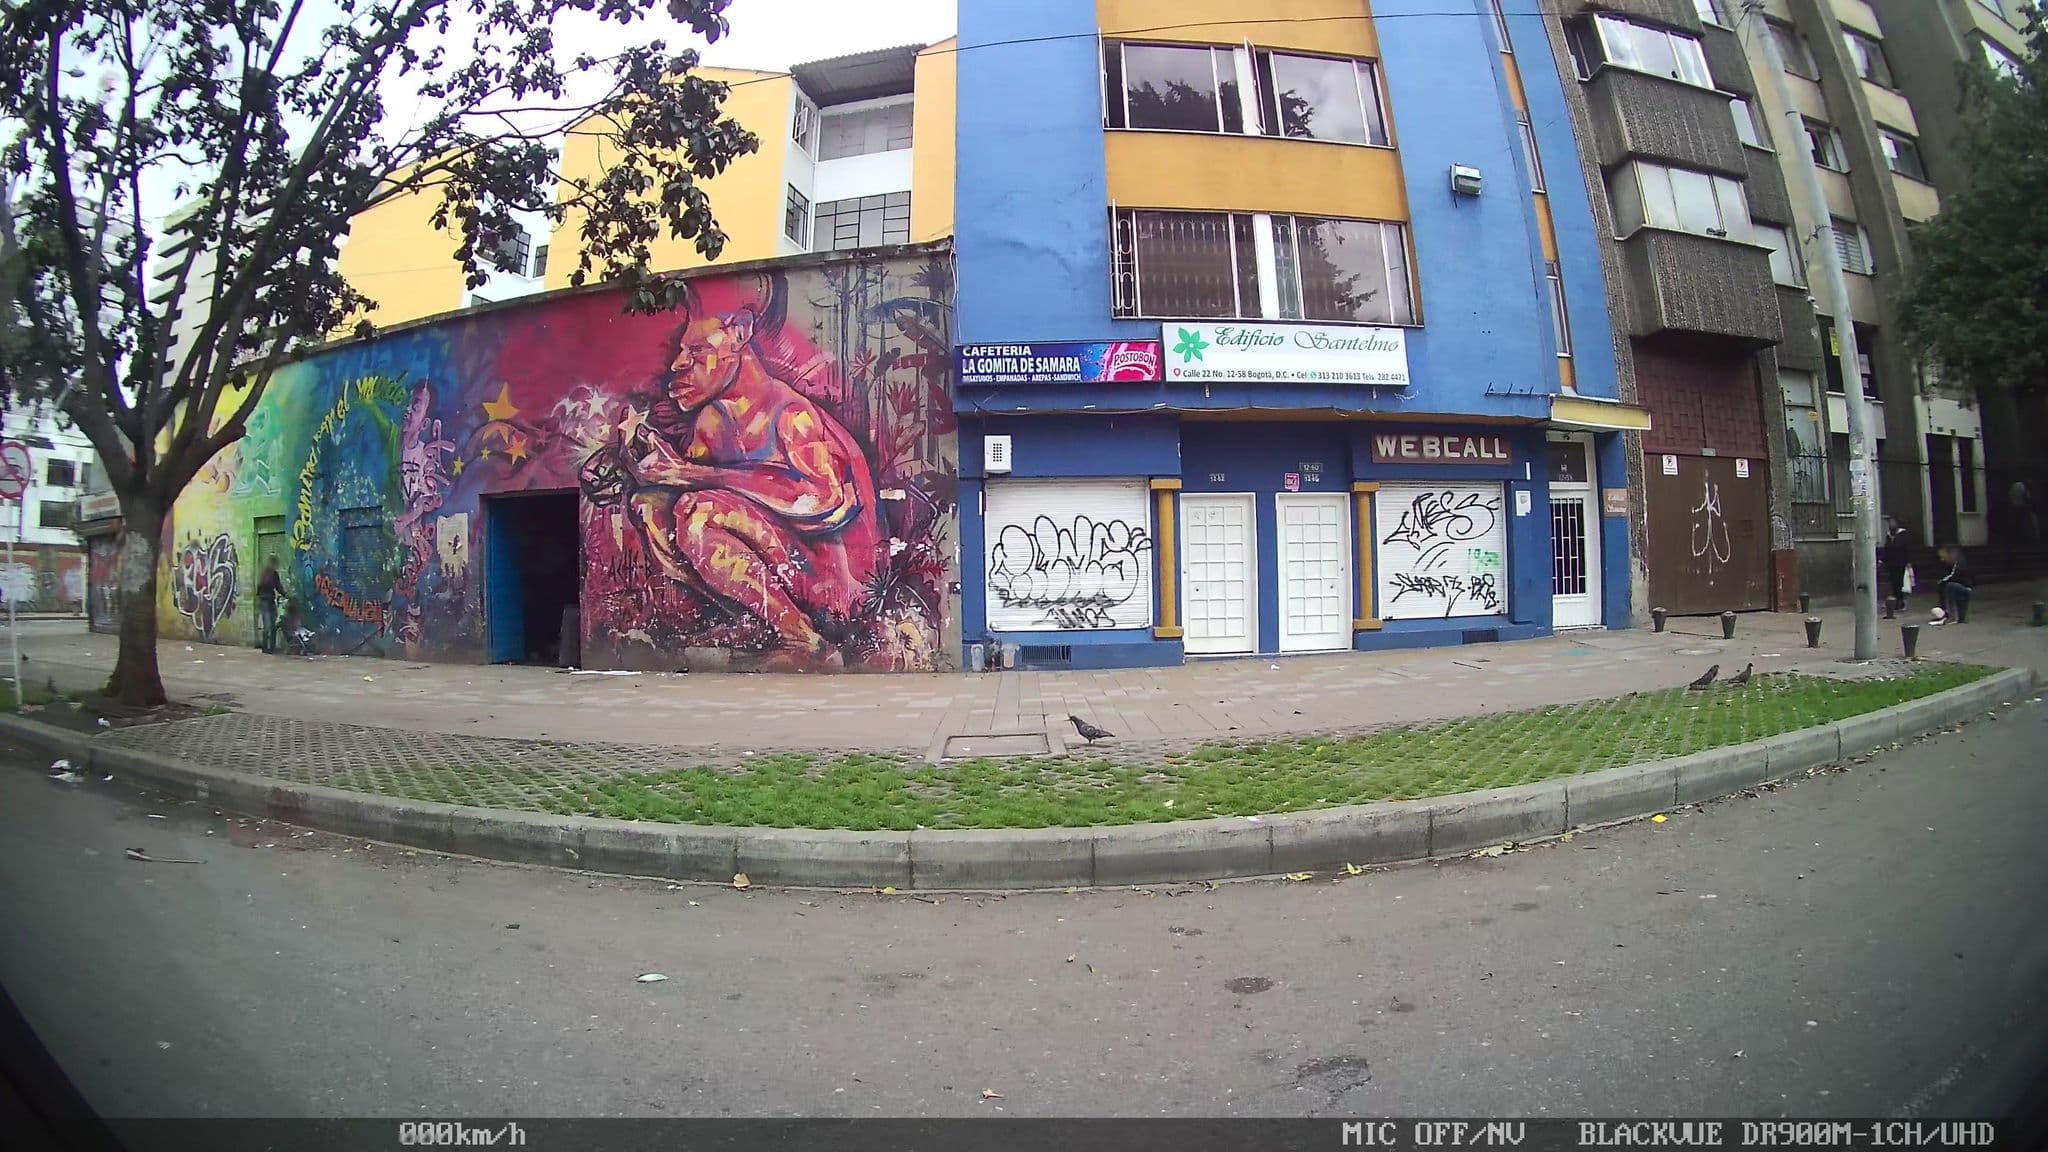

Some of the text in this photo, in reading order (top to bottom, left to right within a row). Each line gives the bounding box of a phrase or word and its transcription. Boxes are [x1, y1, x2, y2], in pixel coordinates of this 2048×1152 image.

[1214, 326, 1399, 353] Edificio Santelmo
[962, 345, 1032, 357] CAFETERIA
[962, 356, 1081, 374] LA GOMITA DE SAMARA
[1182, 369, 1201, 378] Calle
[1202, 369, 1211, 378] 22
[1227, 370, 1247, 378] 12-58
[1375, 435, 1508, 459] WEBCALL
